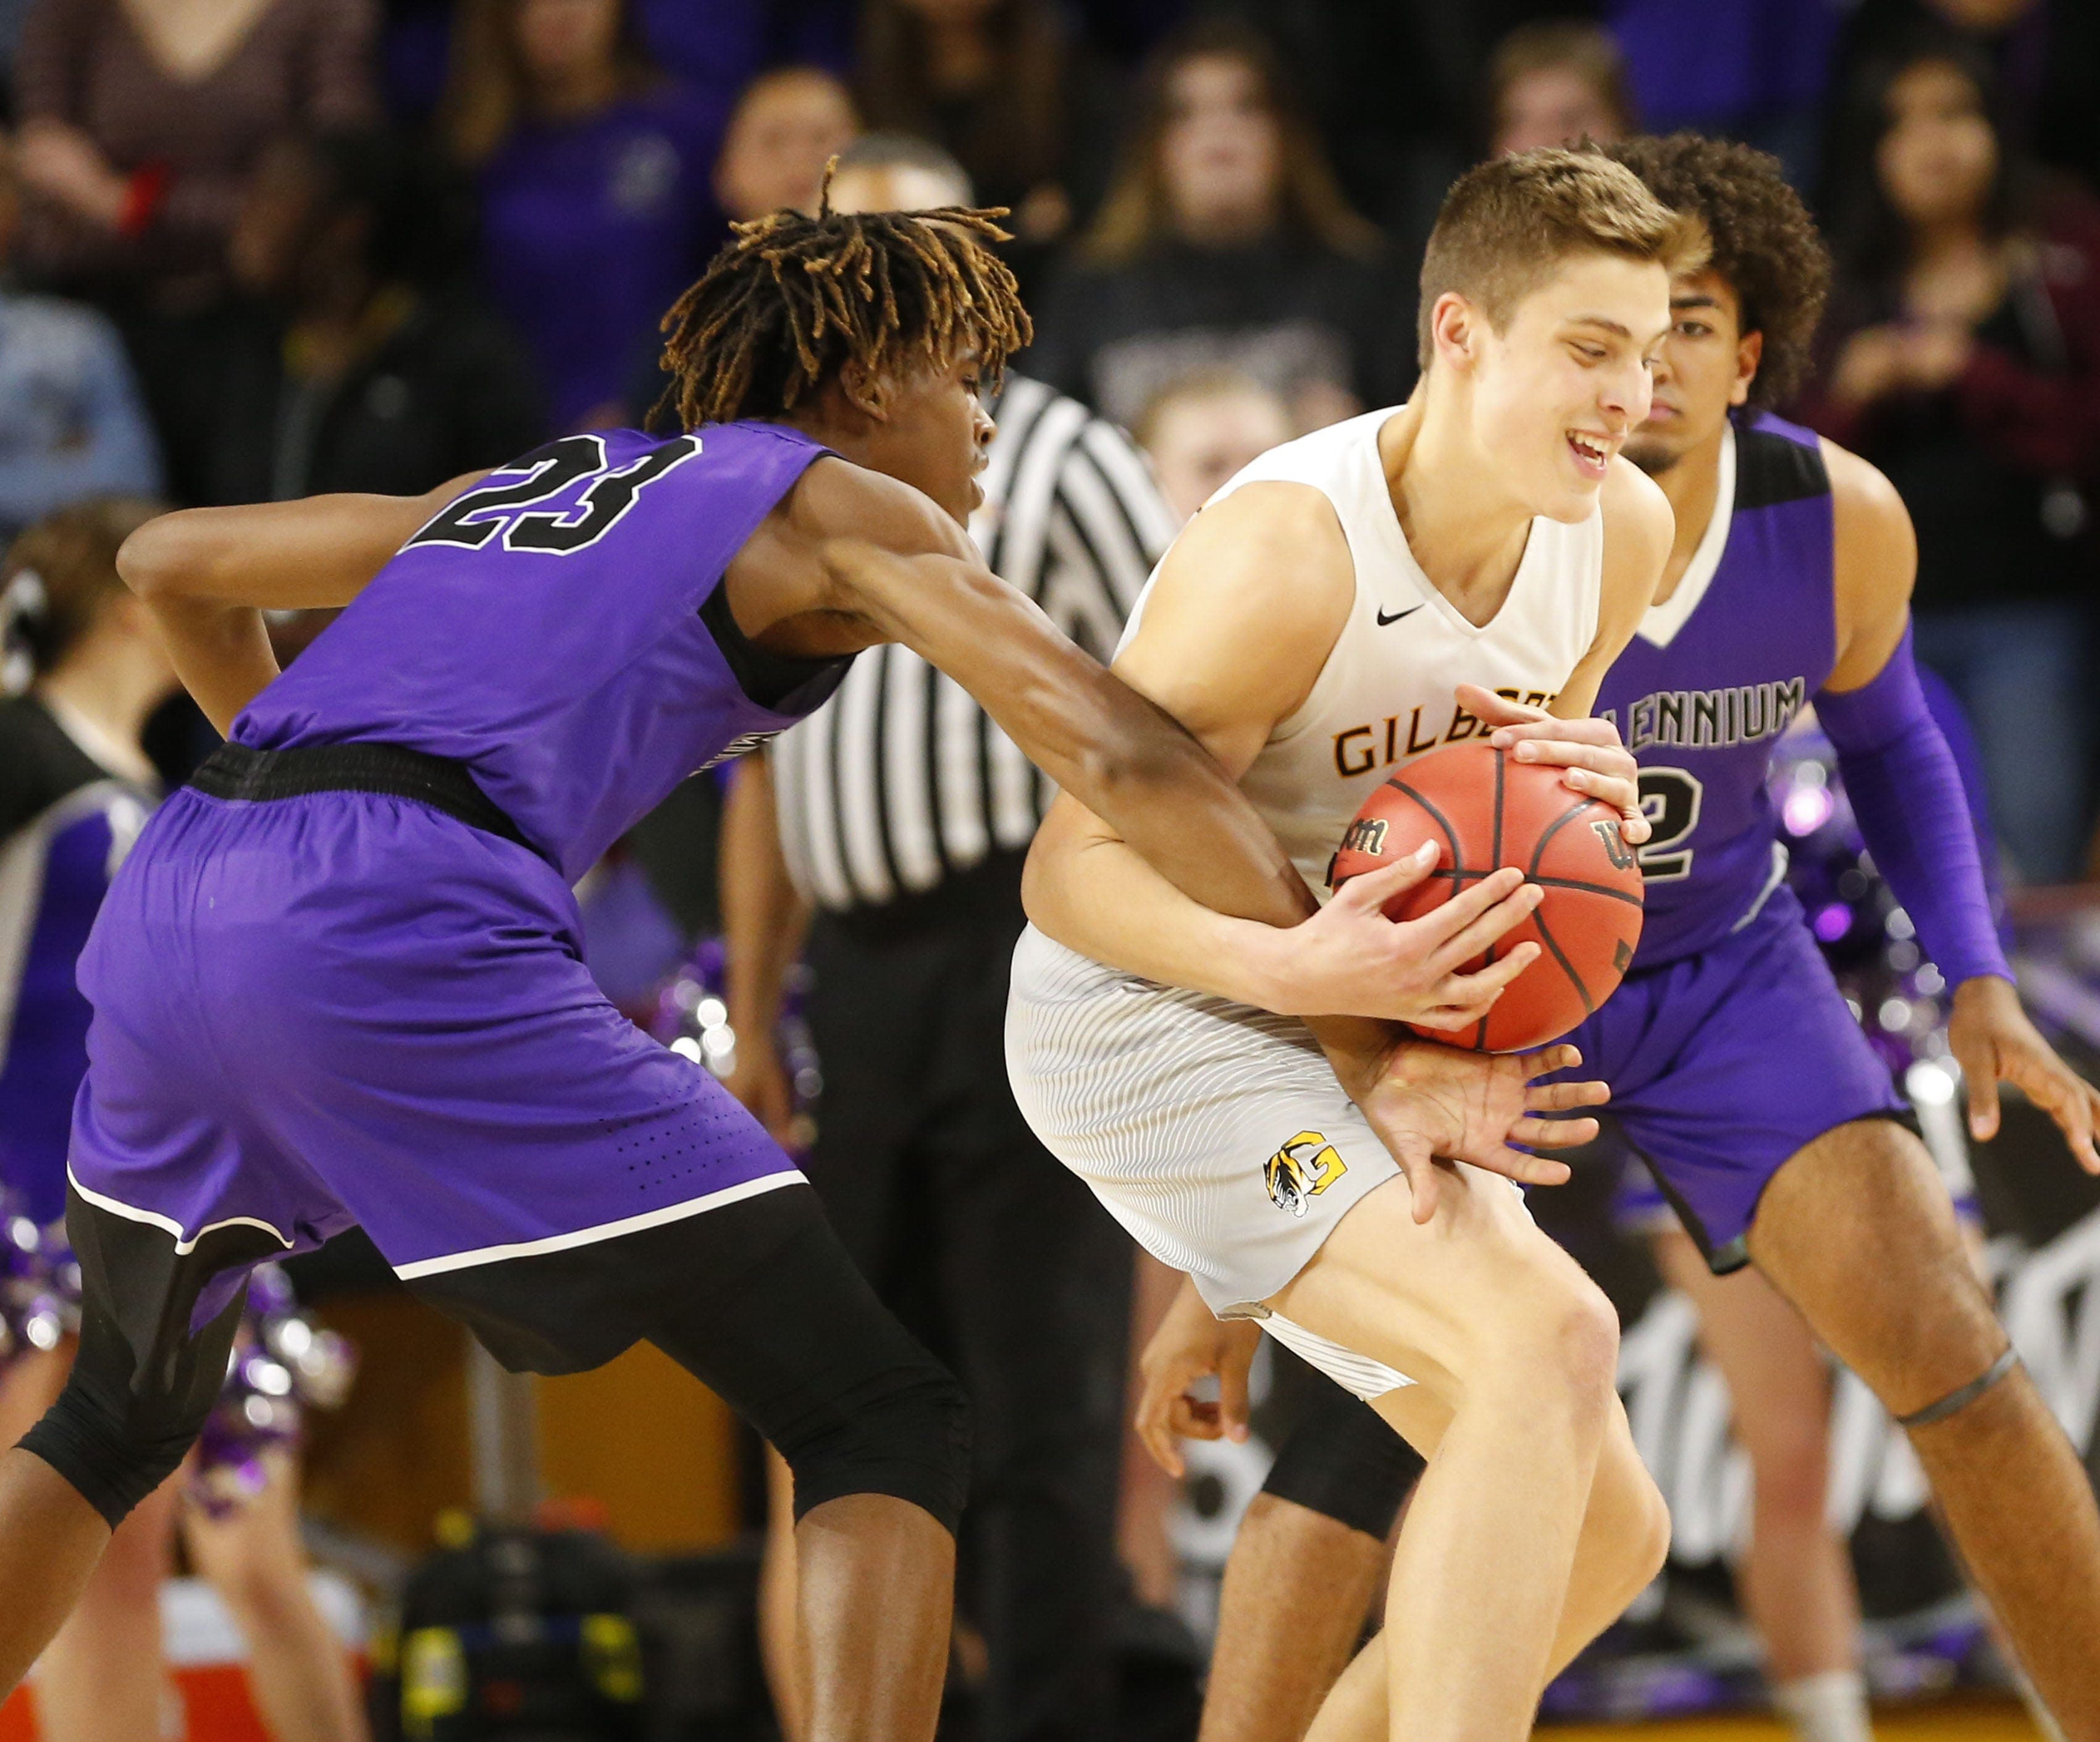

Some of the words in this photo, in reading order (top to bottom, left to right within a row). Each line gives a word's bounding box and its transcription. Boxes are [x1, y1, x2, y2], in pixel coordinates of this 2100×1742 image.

[395, 434, 703, 556] 23
[1332, 688, 1559, 780] GILB
[1600, 676, 1805, 755] ENNIUM
